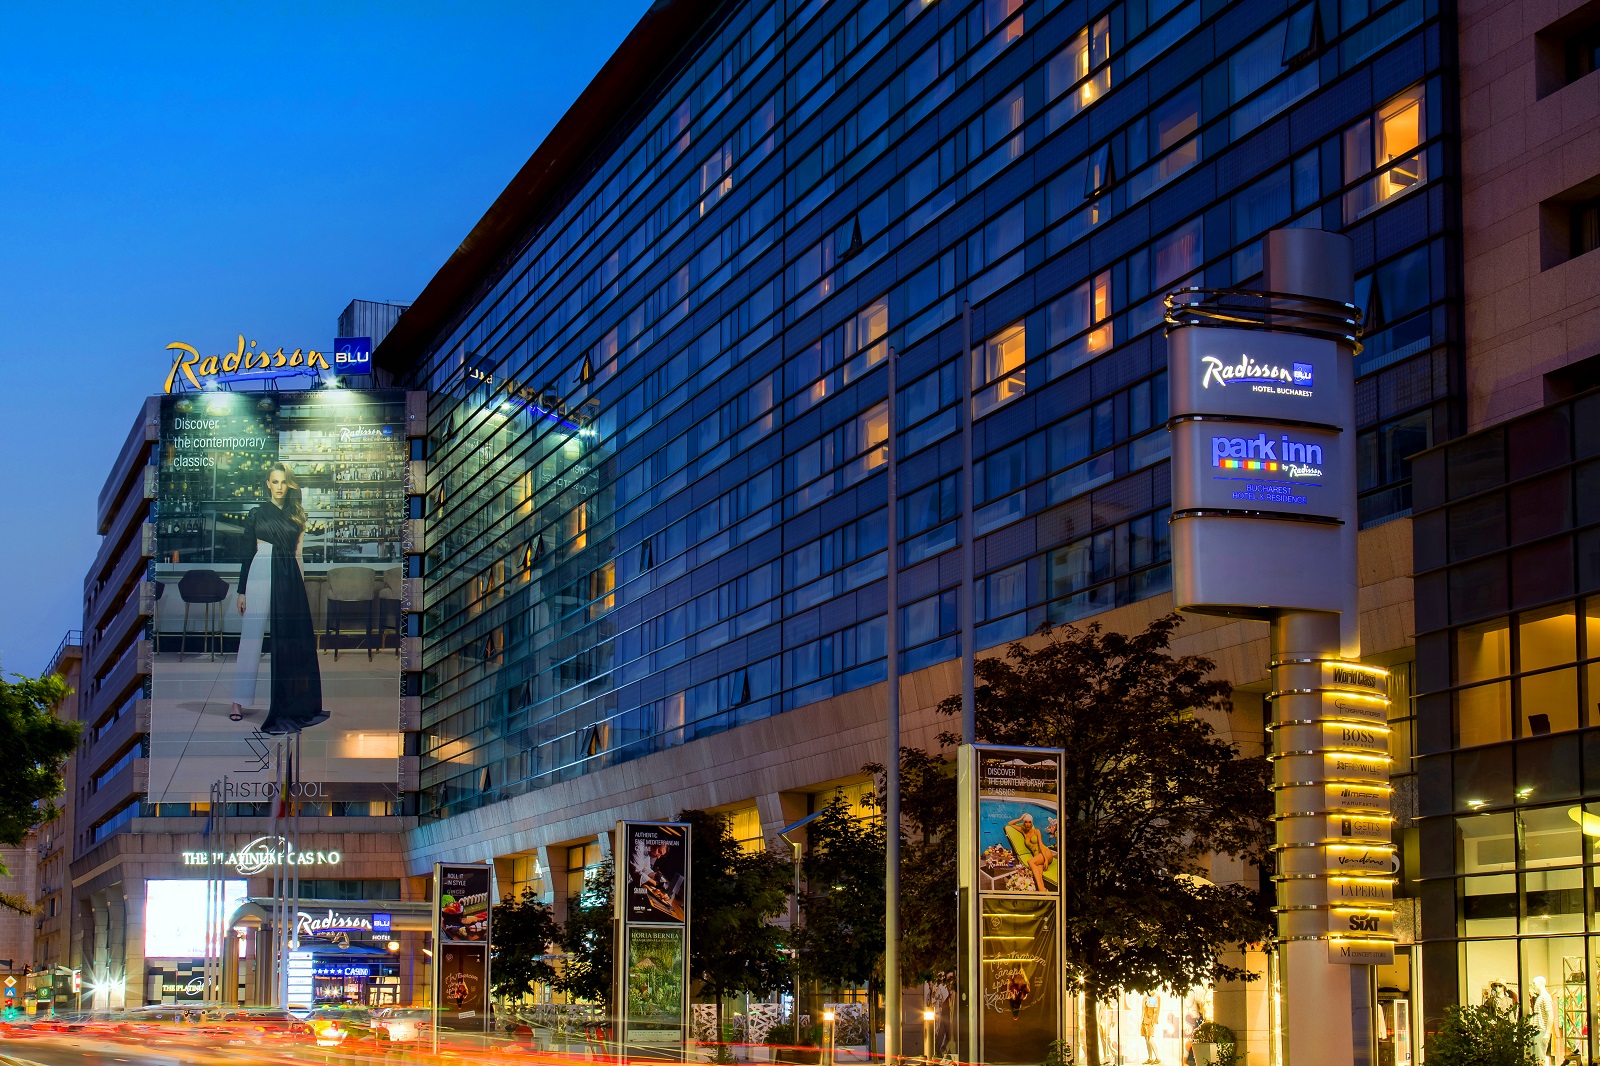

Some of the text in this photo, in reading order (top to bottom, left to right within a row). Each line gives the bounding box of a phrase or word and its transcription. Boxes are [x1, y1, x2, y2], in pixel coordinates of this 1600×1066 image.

[164, 334, 369, 394] Radisson BLU
[1202, 354, 1311, 389] Radisson BLU
[1277, 387, 1313, 397] BUCHAREST
[174, 417, 219, 430] Discover
[341, 425, 383, 441] Radisson
[173, 435, 266, 450] the contemporary
[1212, 433, 1322, 467] park inn
[173, 454, 215, 467] classics
[1289, 464, 1323, 478] Radisson
[1246, 484, 1292, 494] BUCHAREST
[1232, 492, 1257, 500] HOTEL
[1266, 494, 1307, 504] RESIDENCE
[1334, 668, 1376, 688] World Class
[1342, 729, 1375, 744] BOSS
[987, 767, 1017, 776] DISCOVER
[1344, 762, 1381, 772] FREYWILLE
[987, 777, 1045, 788] THE CONTEMPORARY
[211, 782, 329, 798] ARISTOOOL
[987, 787, 1016, 796] CLASSICS
[183, 852, 208, 865] THE
[1341, 884, 1385, 898] LA PERLA
[297, 909, 372, 936] Radisson
[1340, 946, 1351, 958] M
[344, 967, 369, 976] CASINO
[176, 984, 204, 992] PLATINU
